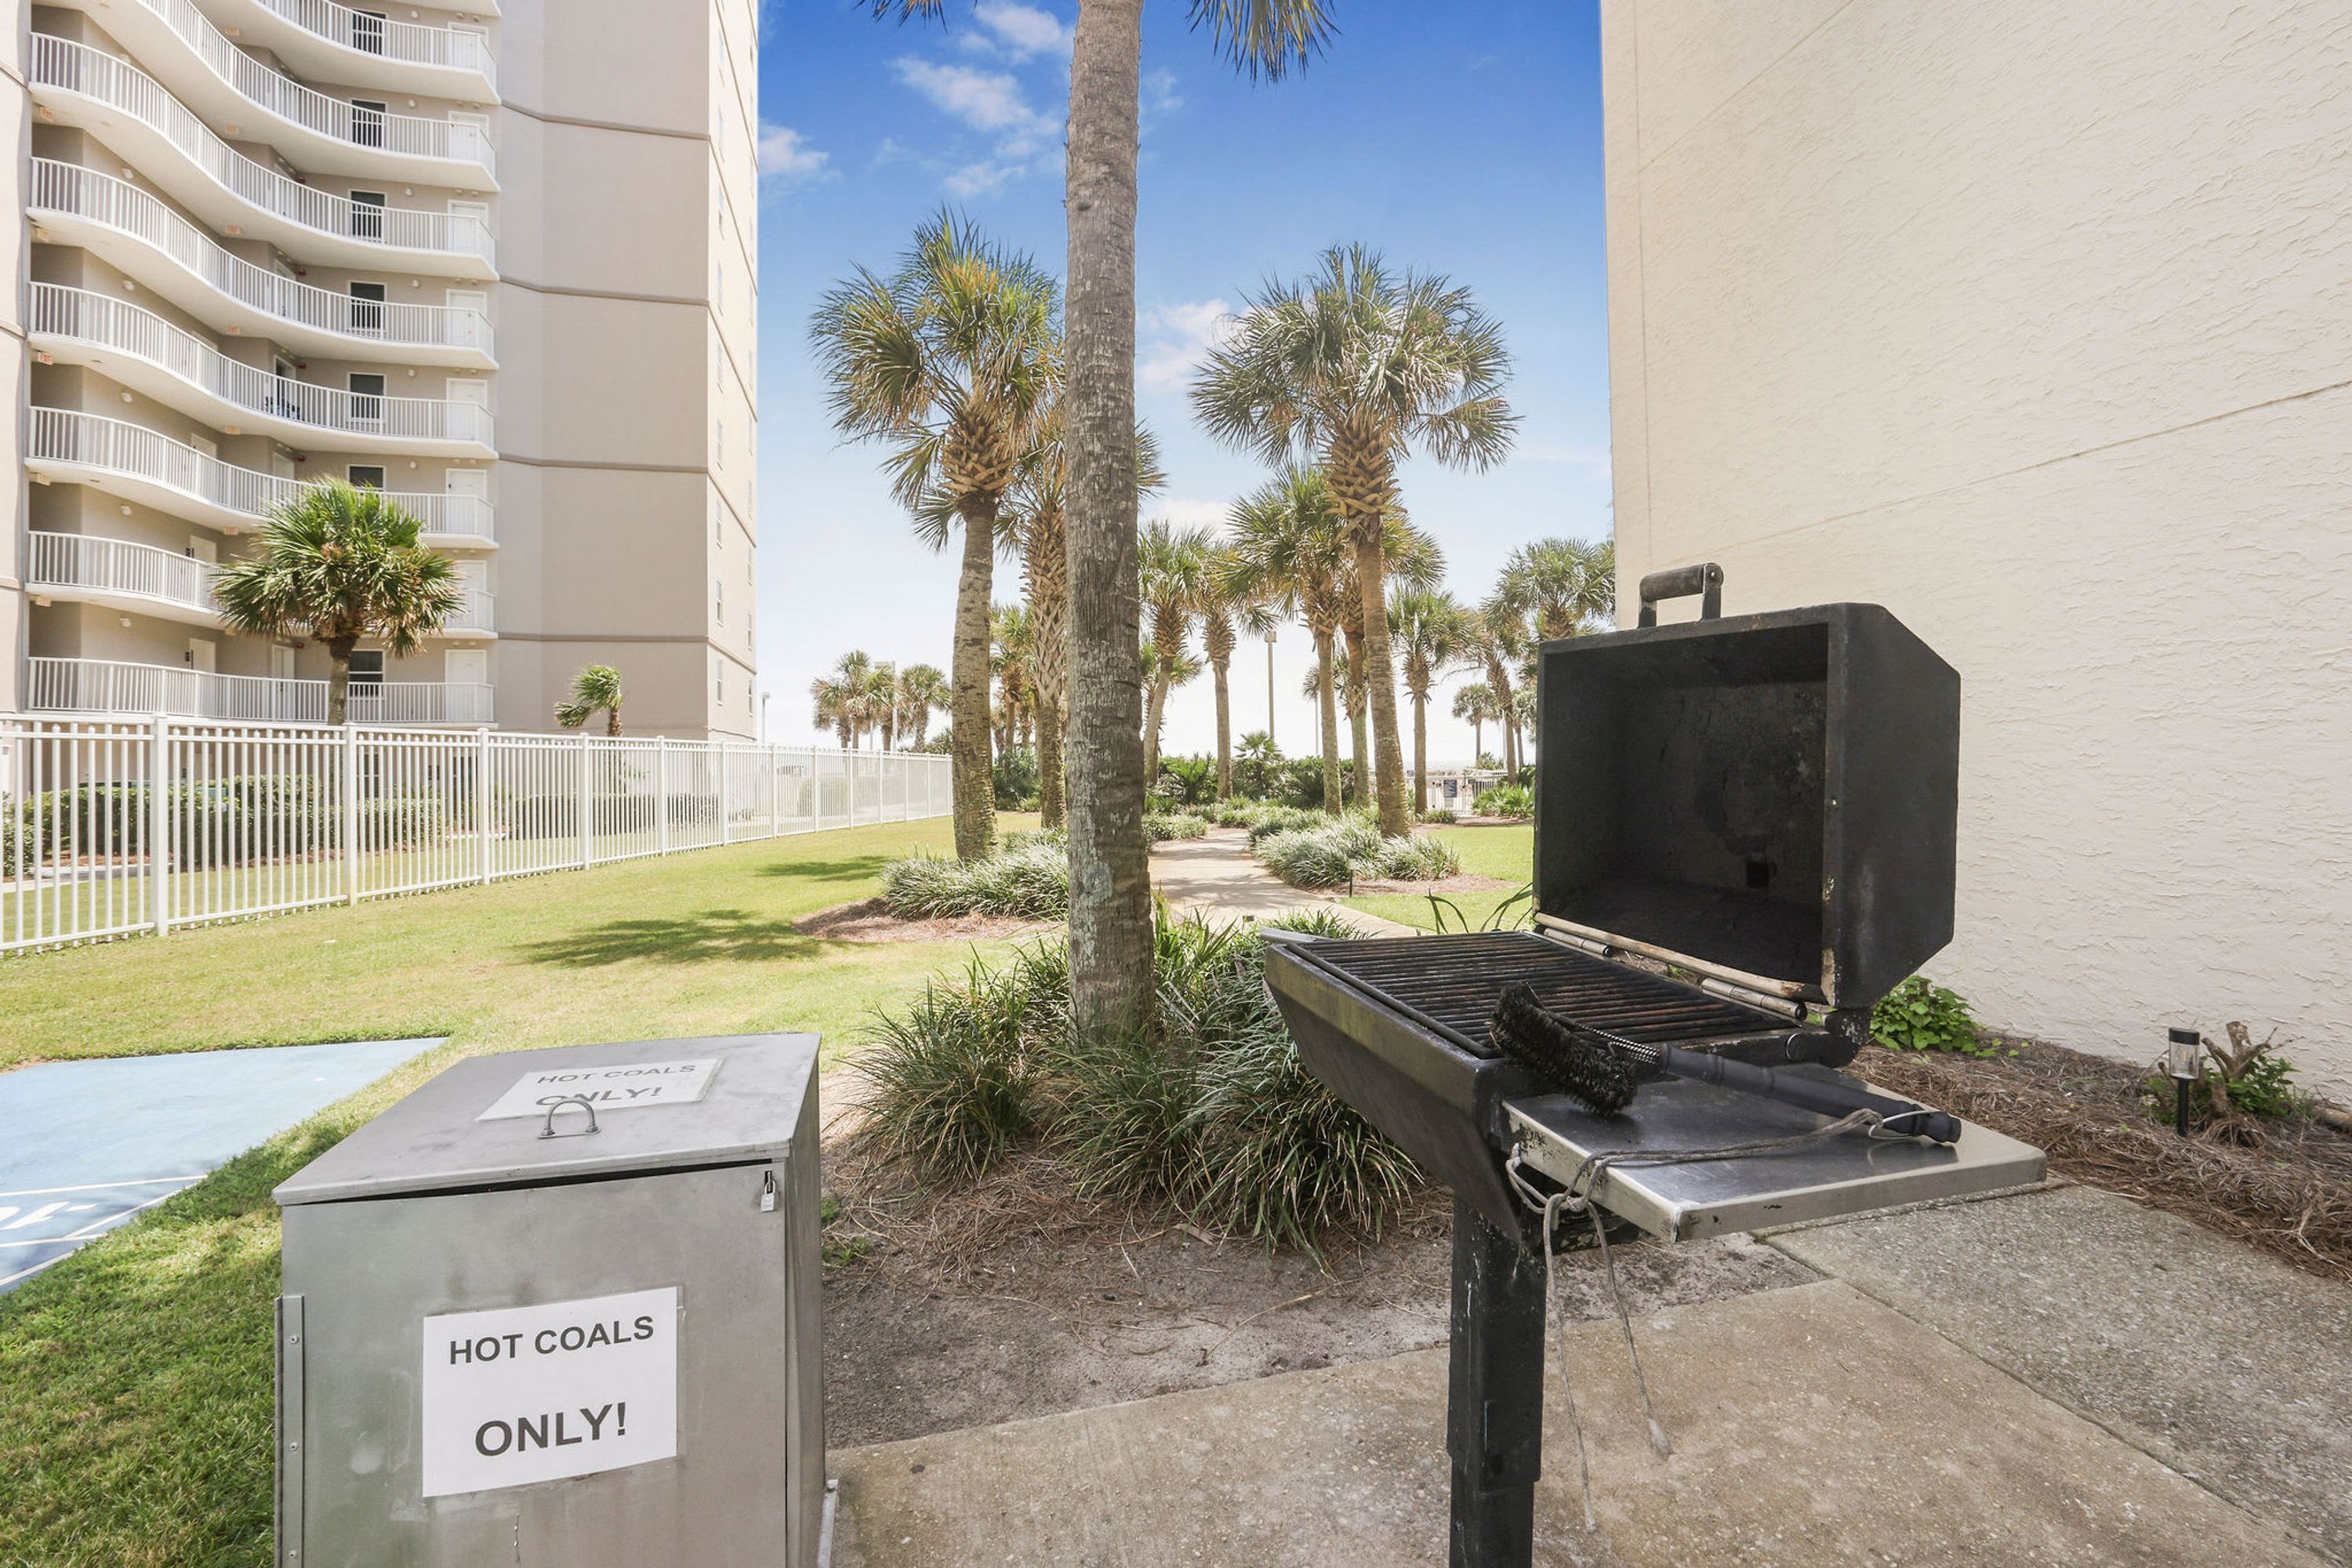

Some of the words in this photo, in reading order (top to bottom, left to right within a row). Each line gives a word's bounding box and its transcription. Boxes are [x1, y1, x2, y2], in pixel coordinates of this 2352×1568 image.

[536, 1073, 599, 1084] HOT
[604, 1064, 696, 1079] COALS
[535, 1086, 663, 1106] ONLY!
[449, 1333, 524, 1365] HOT
[534, 1316, 655, 1356] COALS
[474, 1401, 626, 1457] ONLY!
